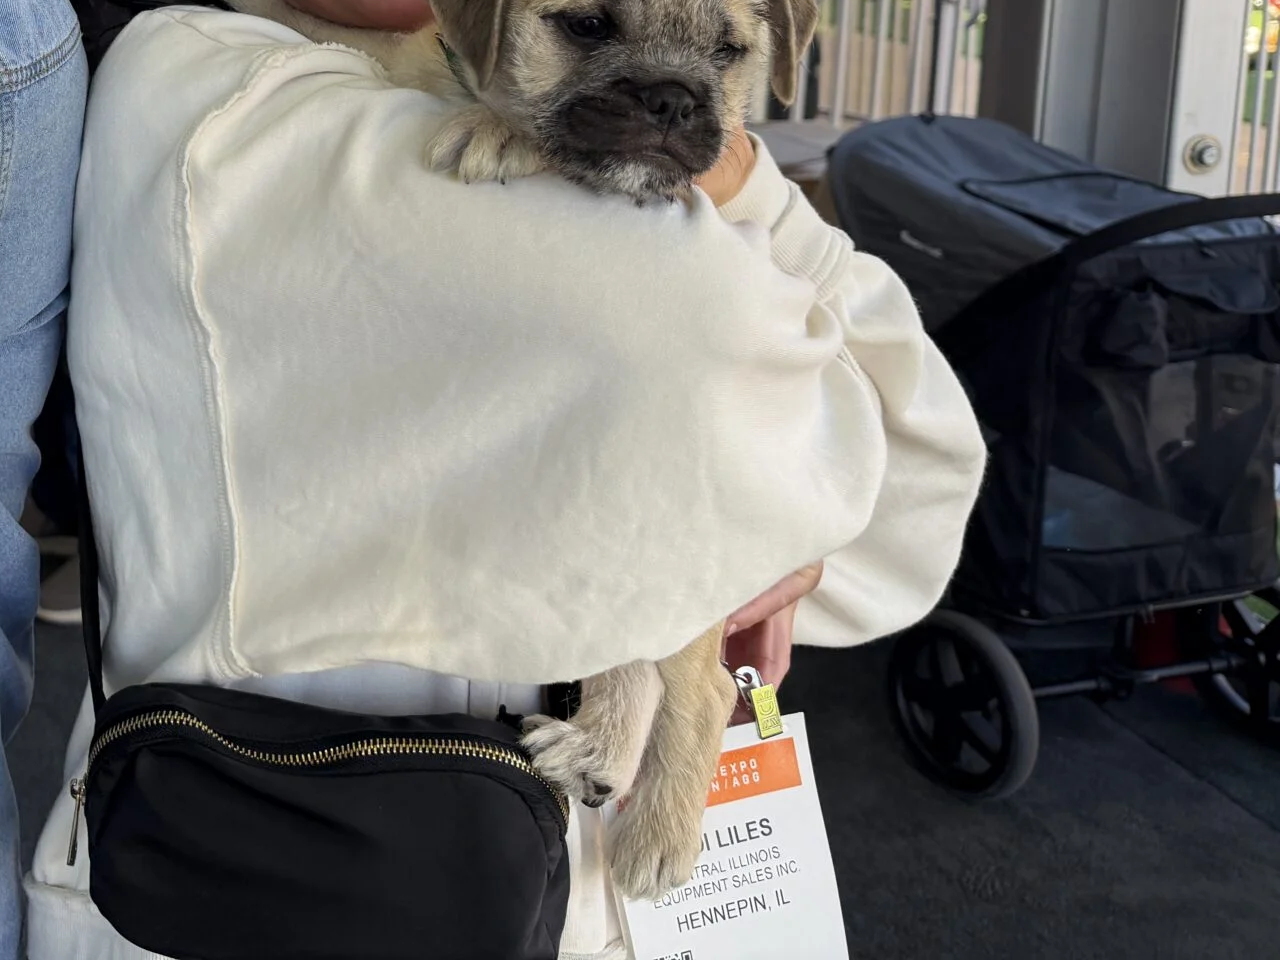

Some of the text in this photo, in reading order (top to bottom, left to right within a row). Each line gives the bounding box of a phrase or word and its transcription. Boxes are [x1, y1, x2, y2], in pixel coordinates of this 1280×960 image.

[713, 758, 758, 778] EXPO
[715, 818, 773, 848] LILES
[691, 846, 781, 880] TRAL ILLINOIS
[654, 860, 801, 909] EQUIPMENT SALES INC.
[676, 888, 791, 933] HENNEPIN, IL
